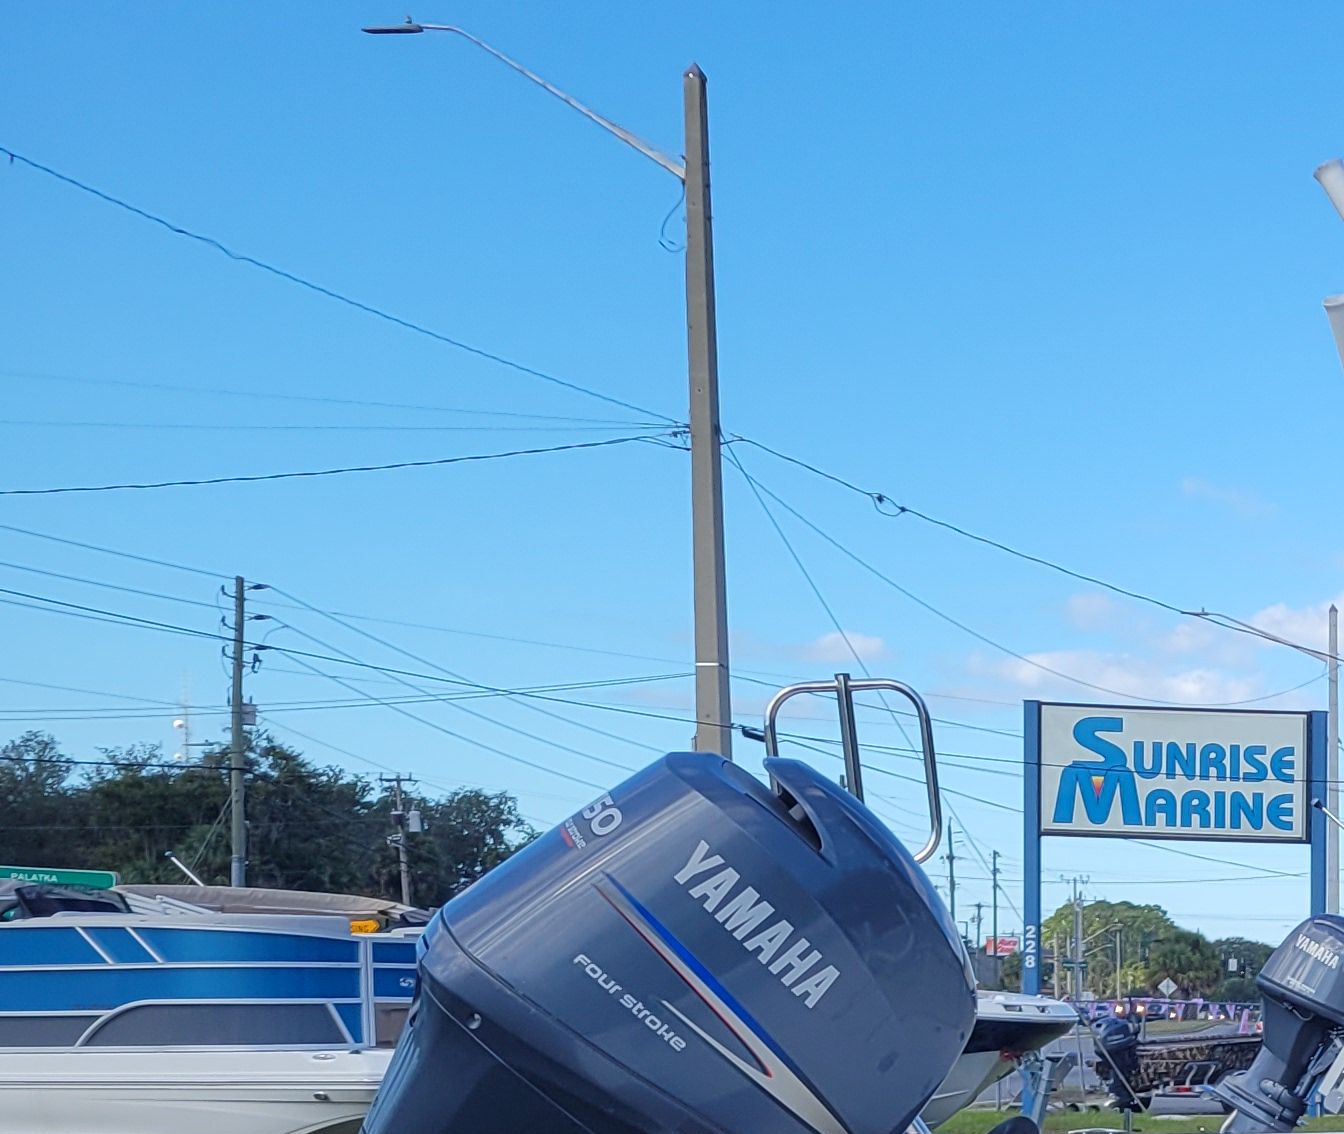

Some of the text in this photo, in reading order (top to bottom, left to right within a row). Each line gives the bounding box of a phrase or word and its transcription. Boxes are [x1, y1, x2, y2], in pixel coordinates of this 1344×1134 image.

[1073, 716, 1295, 783] SUNRISE
[1052, 764, 1293, 831] MARINE
[10, 873, 58, 883] PALATKA
[673, 839, 841, 1009] YAMAHA
[1295, 933, 1340, 969] YAMAHA
